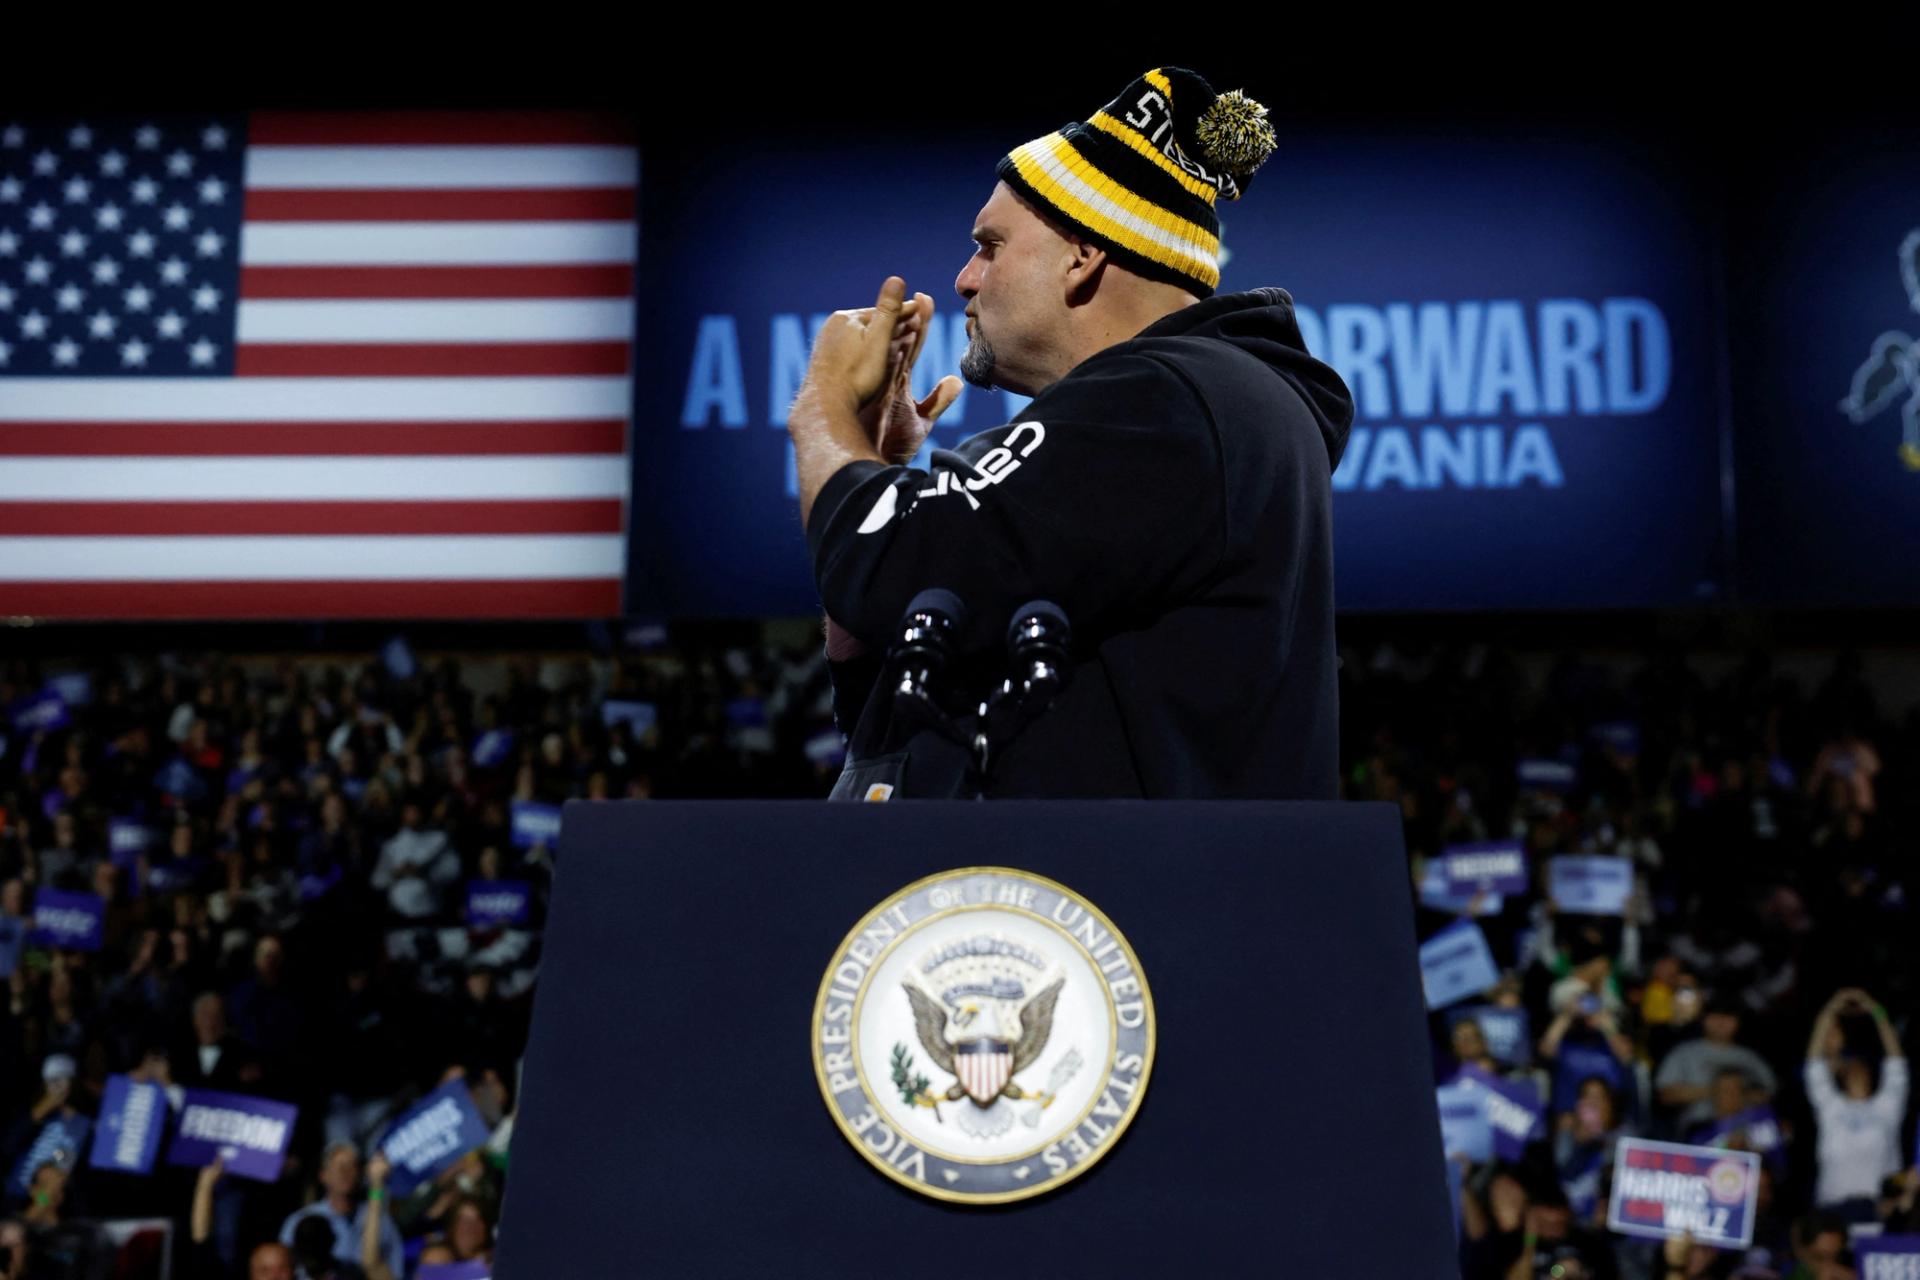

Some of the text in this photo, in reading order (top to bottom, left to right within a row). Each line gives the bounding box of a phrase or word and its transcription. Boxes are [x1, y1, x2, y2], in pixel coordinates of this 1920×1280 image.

[682, 315, 748, 427] A
[928, 886, 966, 909] OF
[980, 882, 1038, 910] THE
[823, 902, 910, 1094] PRESIDENT
[1051, 897, 1145, 1029] UNITED
[851, 1104, 928, 1183] VICE
[1043, 1050, 1143, 1177] STATES
